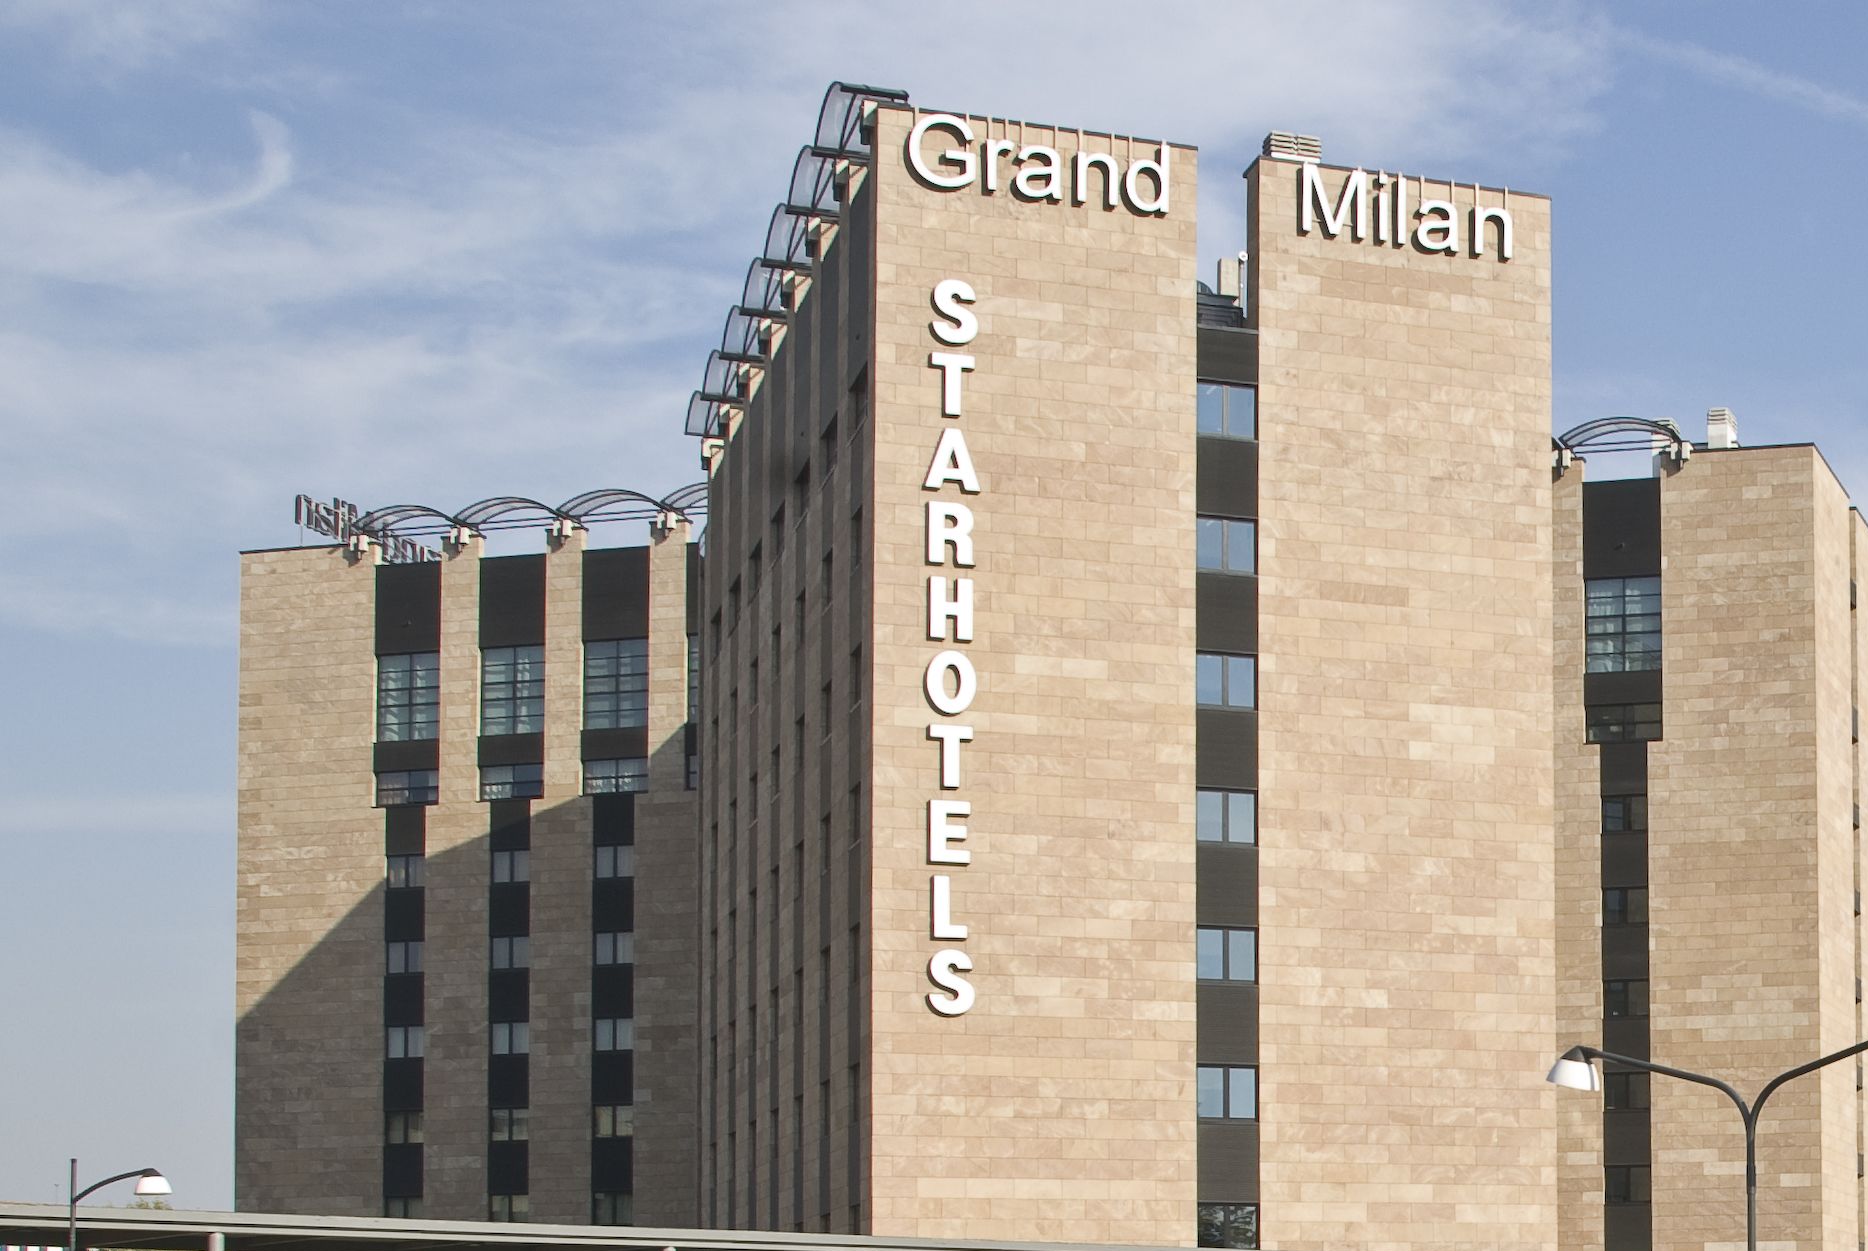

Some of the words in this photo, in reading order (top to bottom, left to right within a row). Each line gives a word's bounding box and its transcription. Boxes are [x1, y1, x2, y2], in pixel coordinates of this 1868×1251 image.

[908, 112, 1171, 214] Grand
[1300, 162, 1514, 260] Milan
[926, 278, 980, 1015] STARHOTELS
